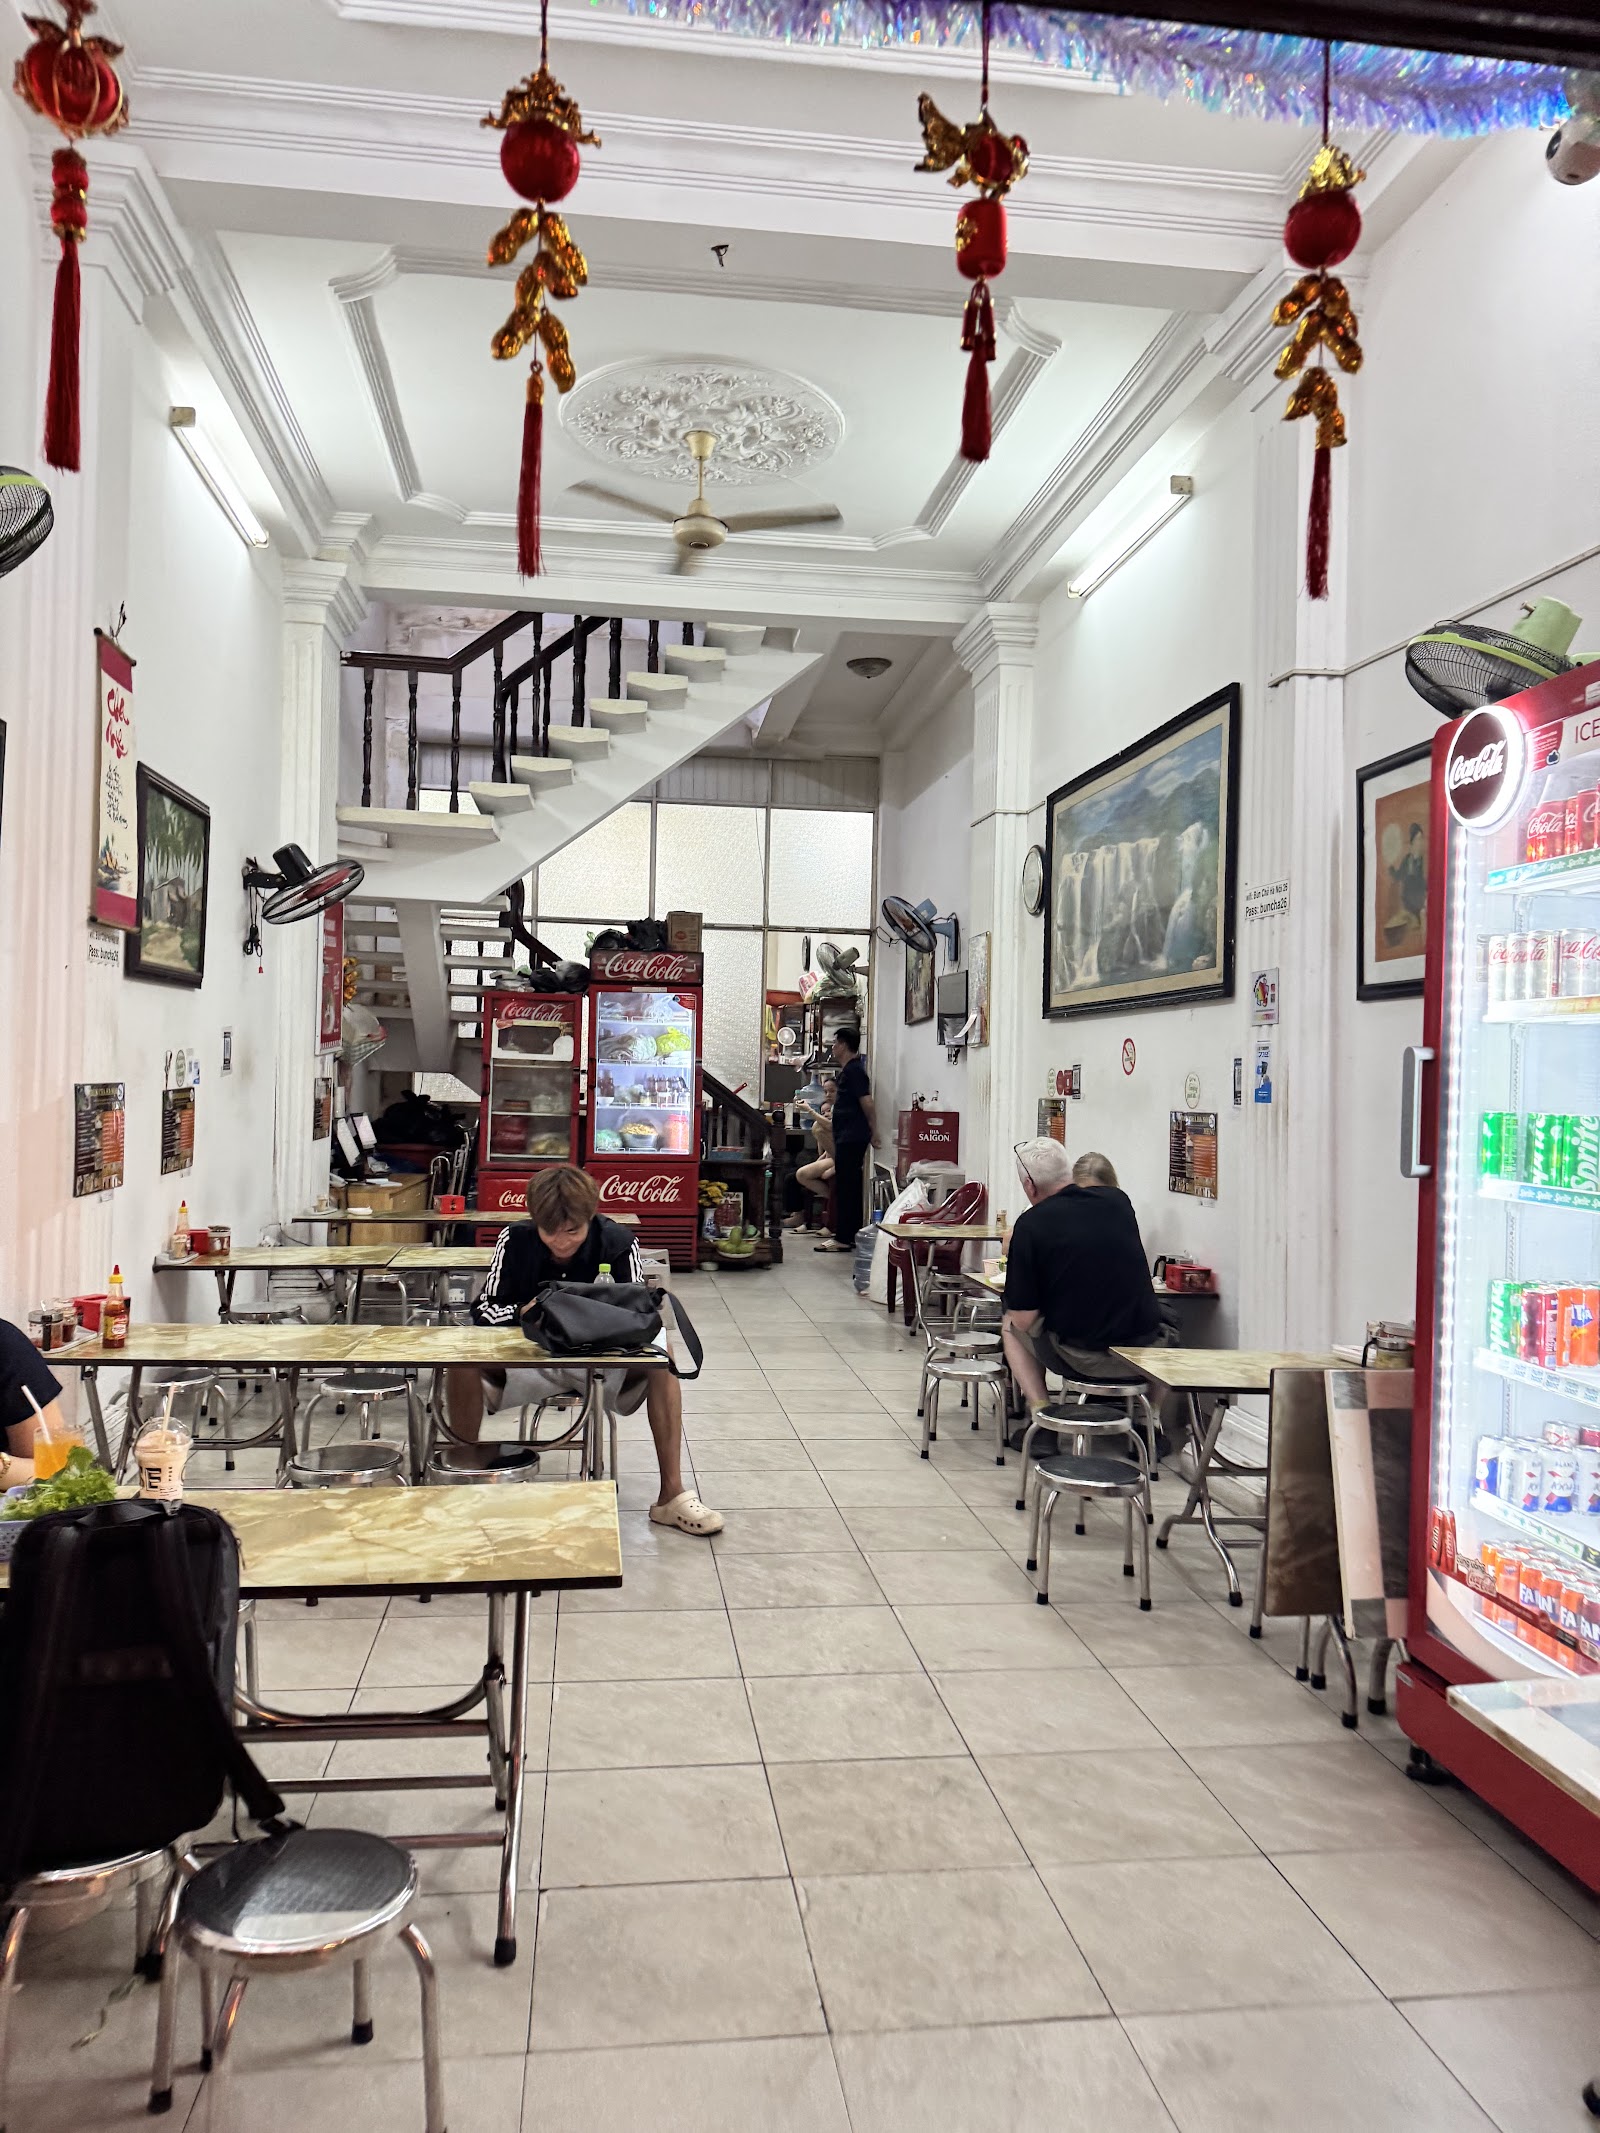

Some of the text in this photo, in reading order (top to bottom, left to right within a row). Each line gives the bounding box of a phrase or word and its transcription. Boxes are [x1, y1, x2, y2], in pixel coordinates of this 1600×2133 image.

[1449, 739, 1507, 791] Coca-Cola
[604, 952, 689, 981] Coca-Cola
[501, 1001, 569, 1021] Coca-Cola
[918, 1133, 950, 1142] SAIGON
[599, 1174, 685, 1204] Coca-Cola
